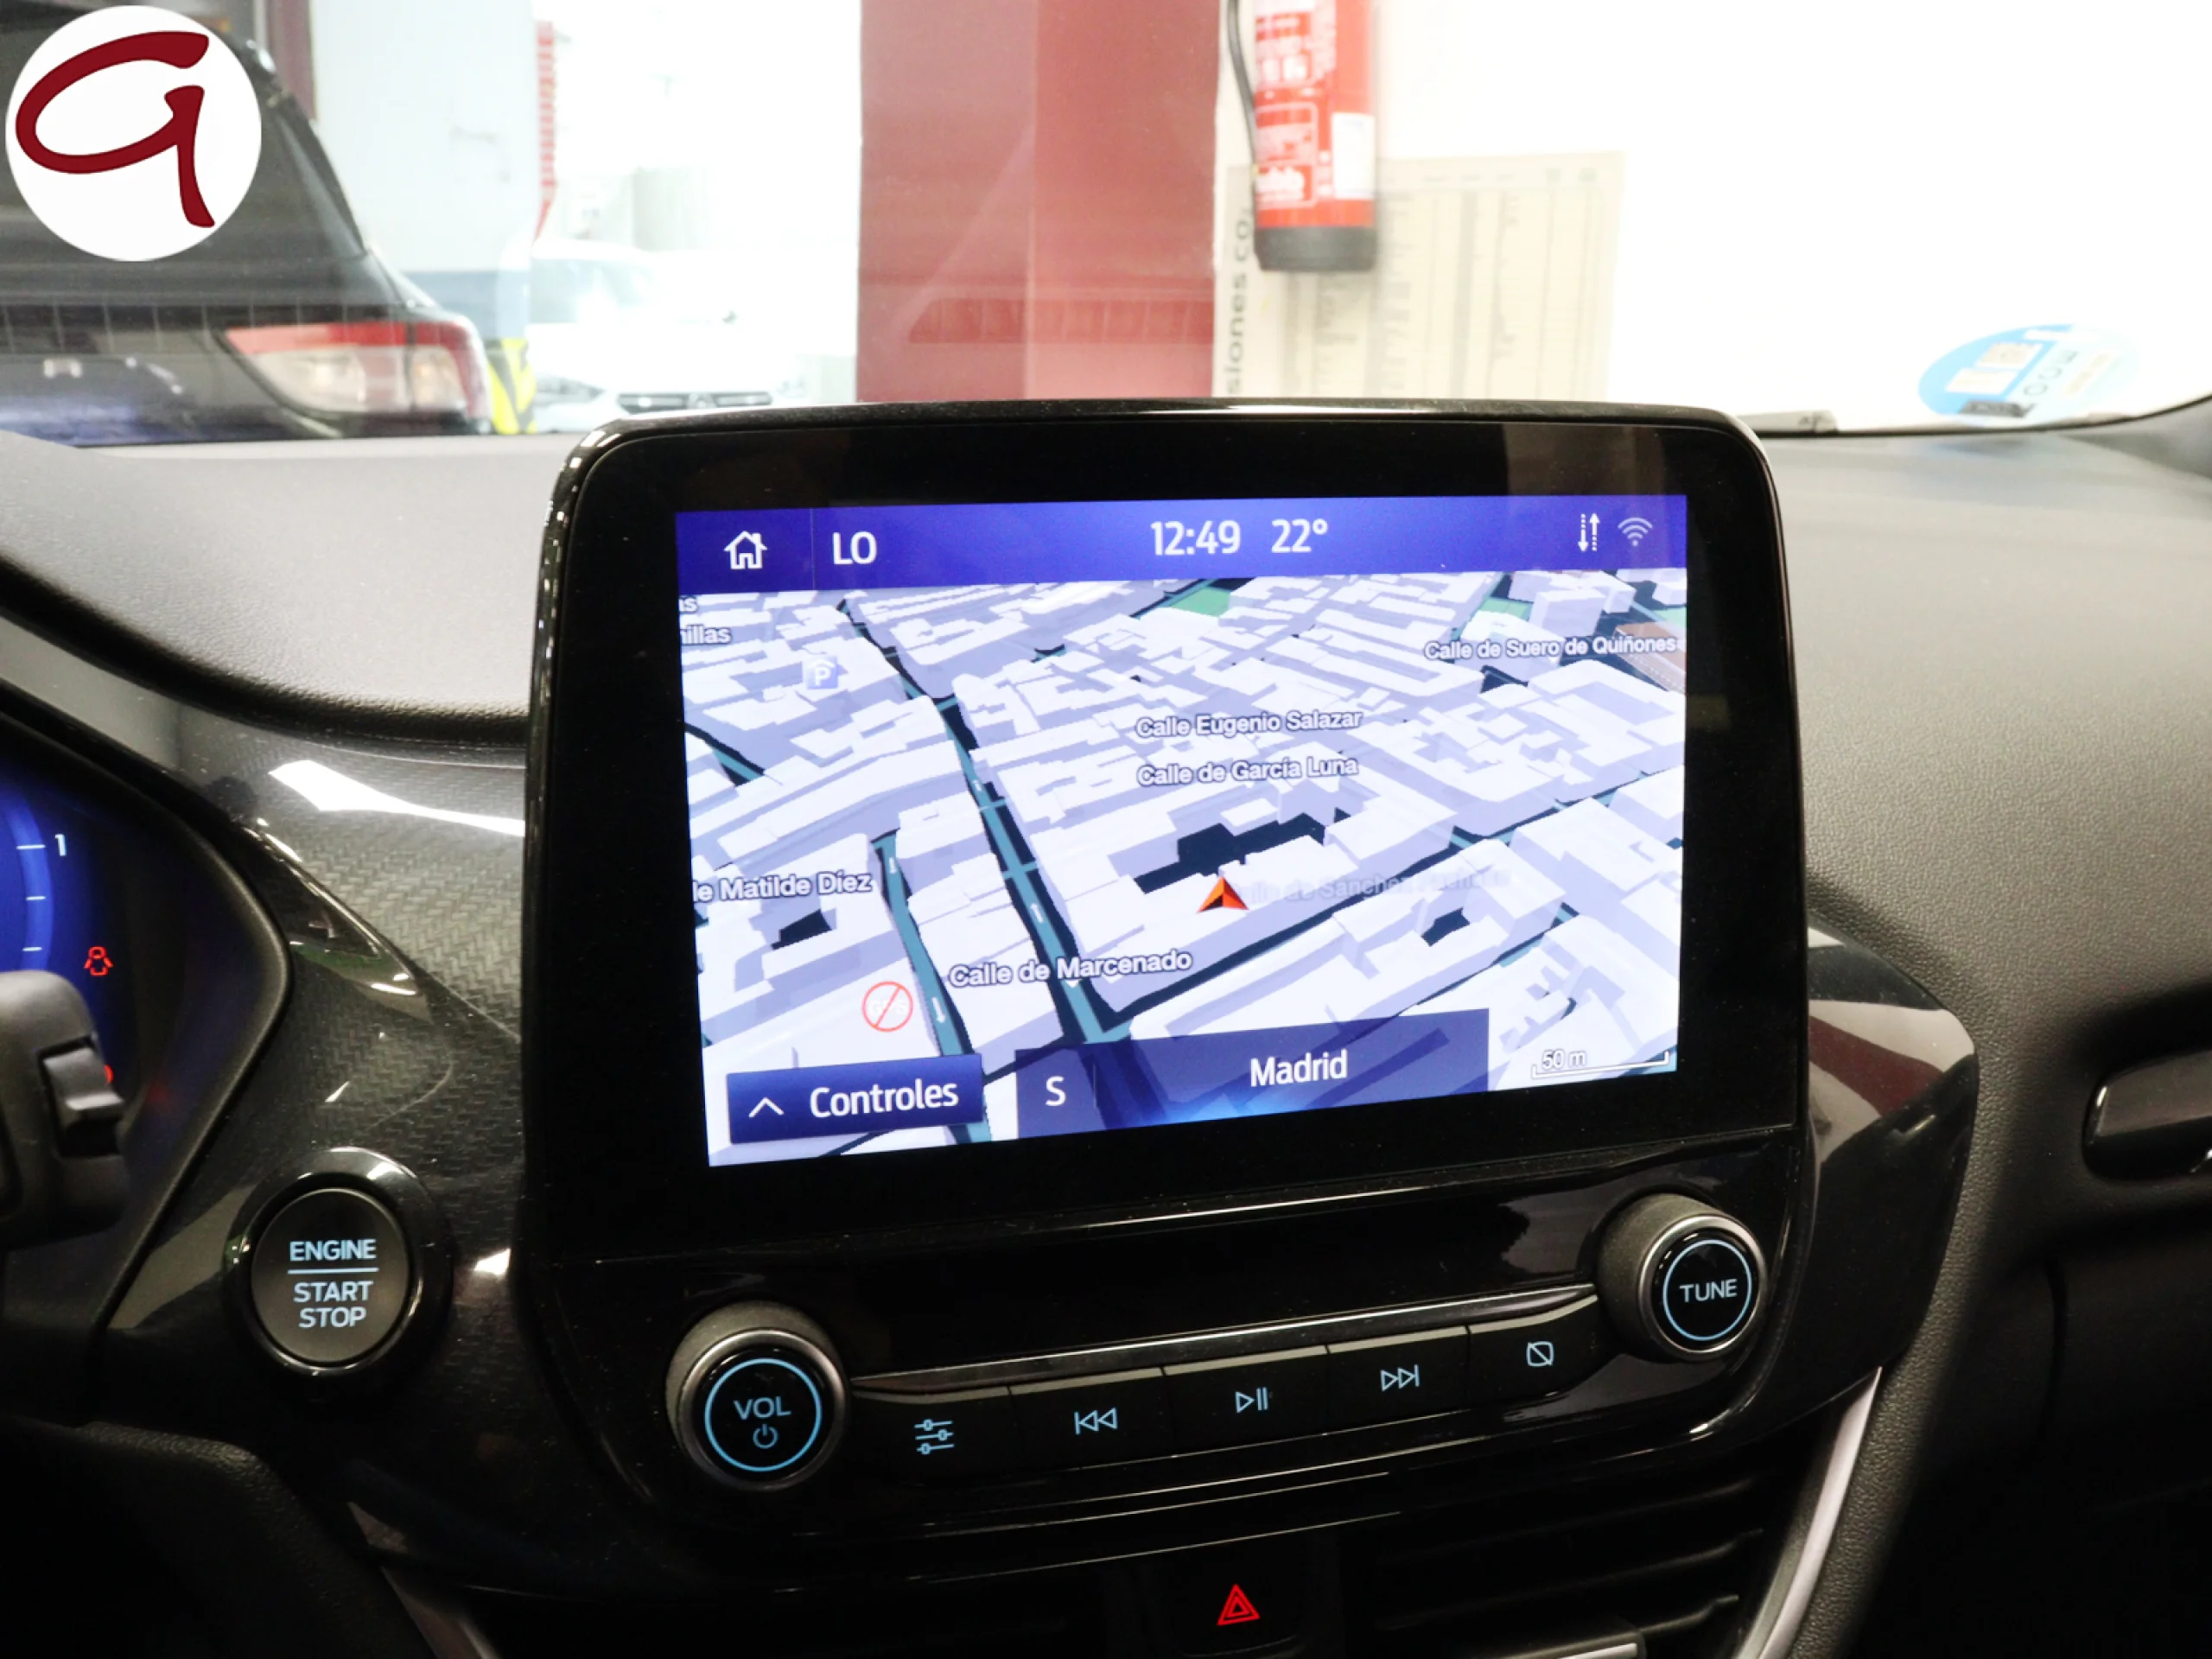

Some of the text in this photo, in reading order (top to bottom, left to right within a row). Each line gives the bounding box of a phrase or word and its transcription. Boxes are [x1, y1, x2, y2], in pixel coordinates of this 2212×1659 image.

[831, 531, 878, 566] LO
[1150, 518, 1241, 556] 12:49
[1425, 634, 1679, 660] Calle de Suero de Quiñones
[1136, 709, 1363, 739] Calle Eugenio Salazar
[1137, 756, 1358, 786] Calle de García Luna
[719, 874, 811, 901] Matilde
[817, 869, 873, 895] Díez
[949, 949, 1192, 988] Calle de Marcenado
[1249, 1048, 1349, 1089] Madrid
[1541, 1048, 1587, 1071] 50 m
[810, 1077, 960, 1118] Controles
[1046, 1075, 1066, 1108] S
[289, 1237, 378, 1262] ENGINE
[293, 1280, 374, 1303] START
[1678, 1278, 1738, 1303] TUNE
[298, 1306, 367, 1328] STOP
[733, 1395, 792, 1421] VOL
